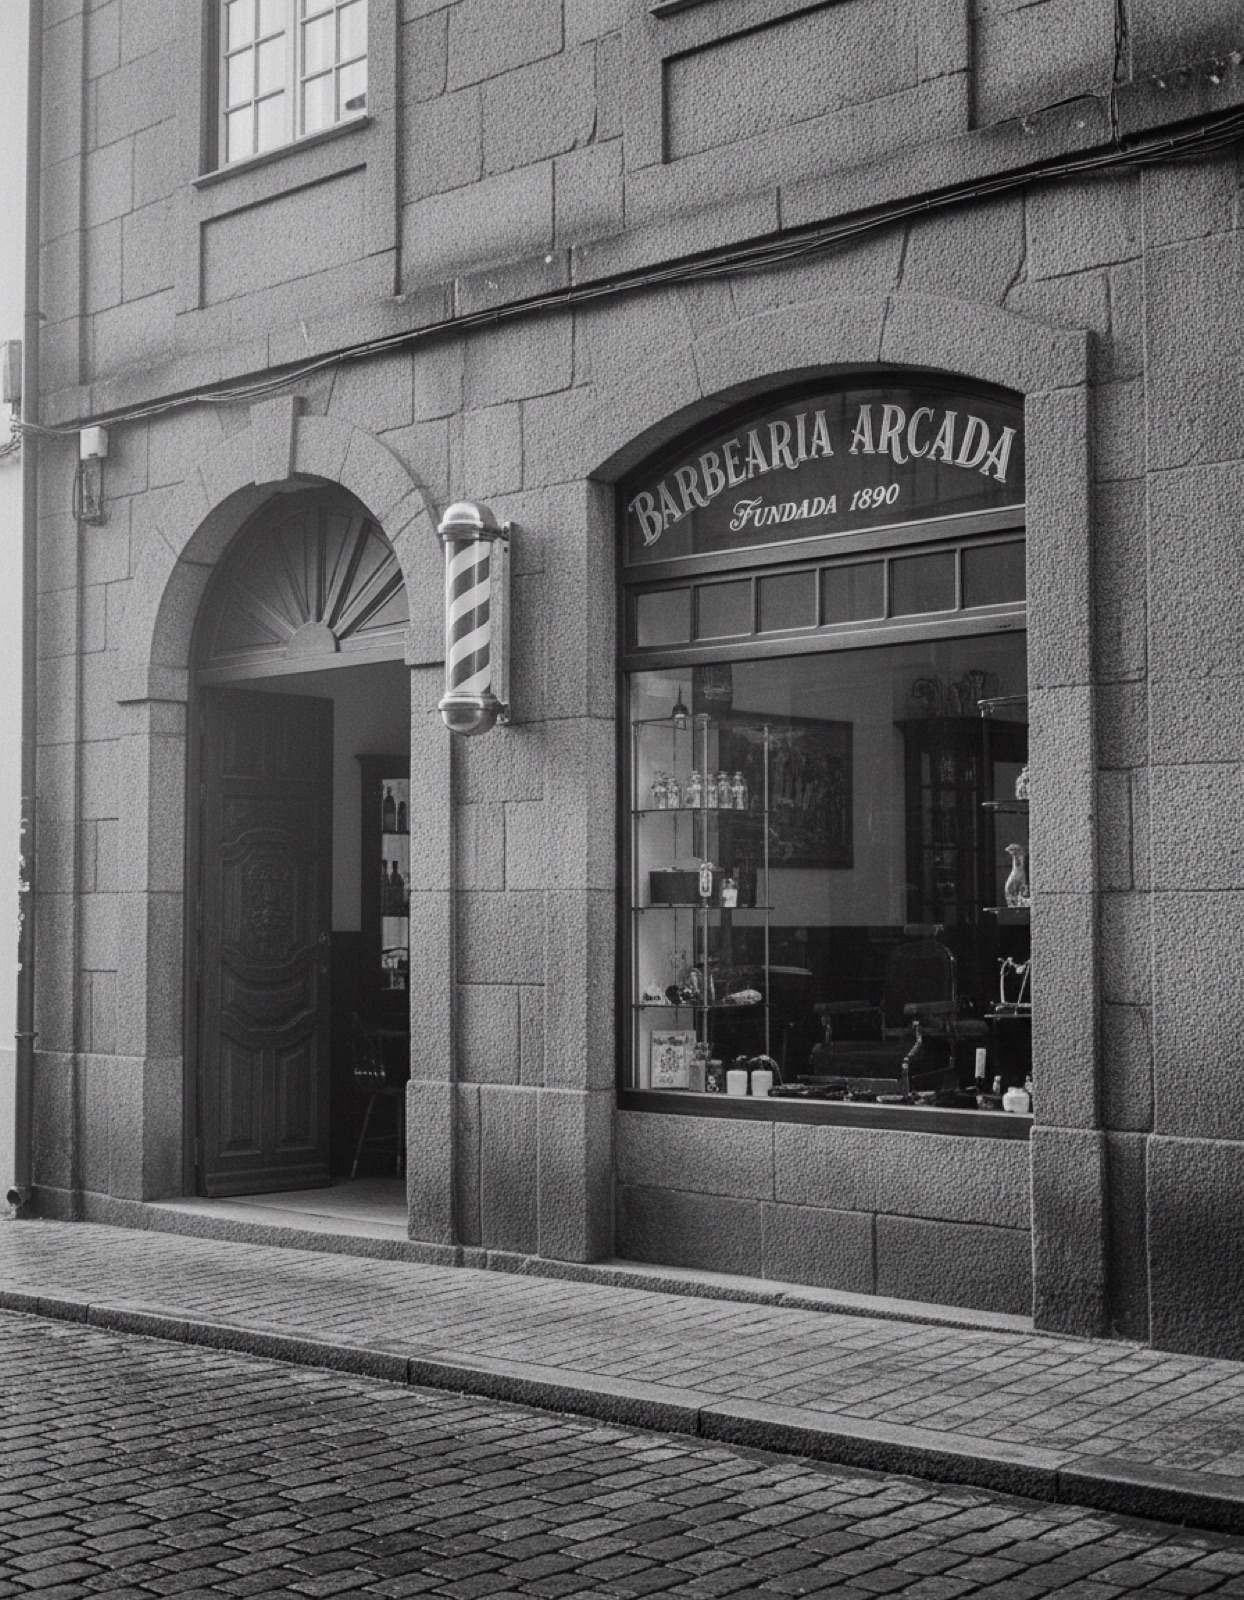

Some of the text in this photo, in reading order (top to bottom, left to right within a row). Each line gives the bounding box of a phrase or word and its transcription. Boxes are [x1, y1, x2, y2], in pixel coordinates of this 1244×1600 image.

[628, 404, 1017, 547] BARBEARIA ARCADA
[729, 484, 900, 531] FUNDADA 1890
